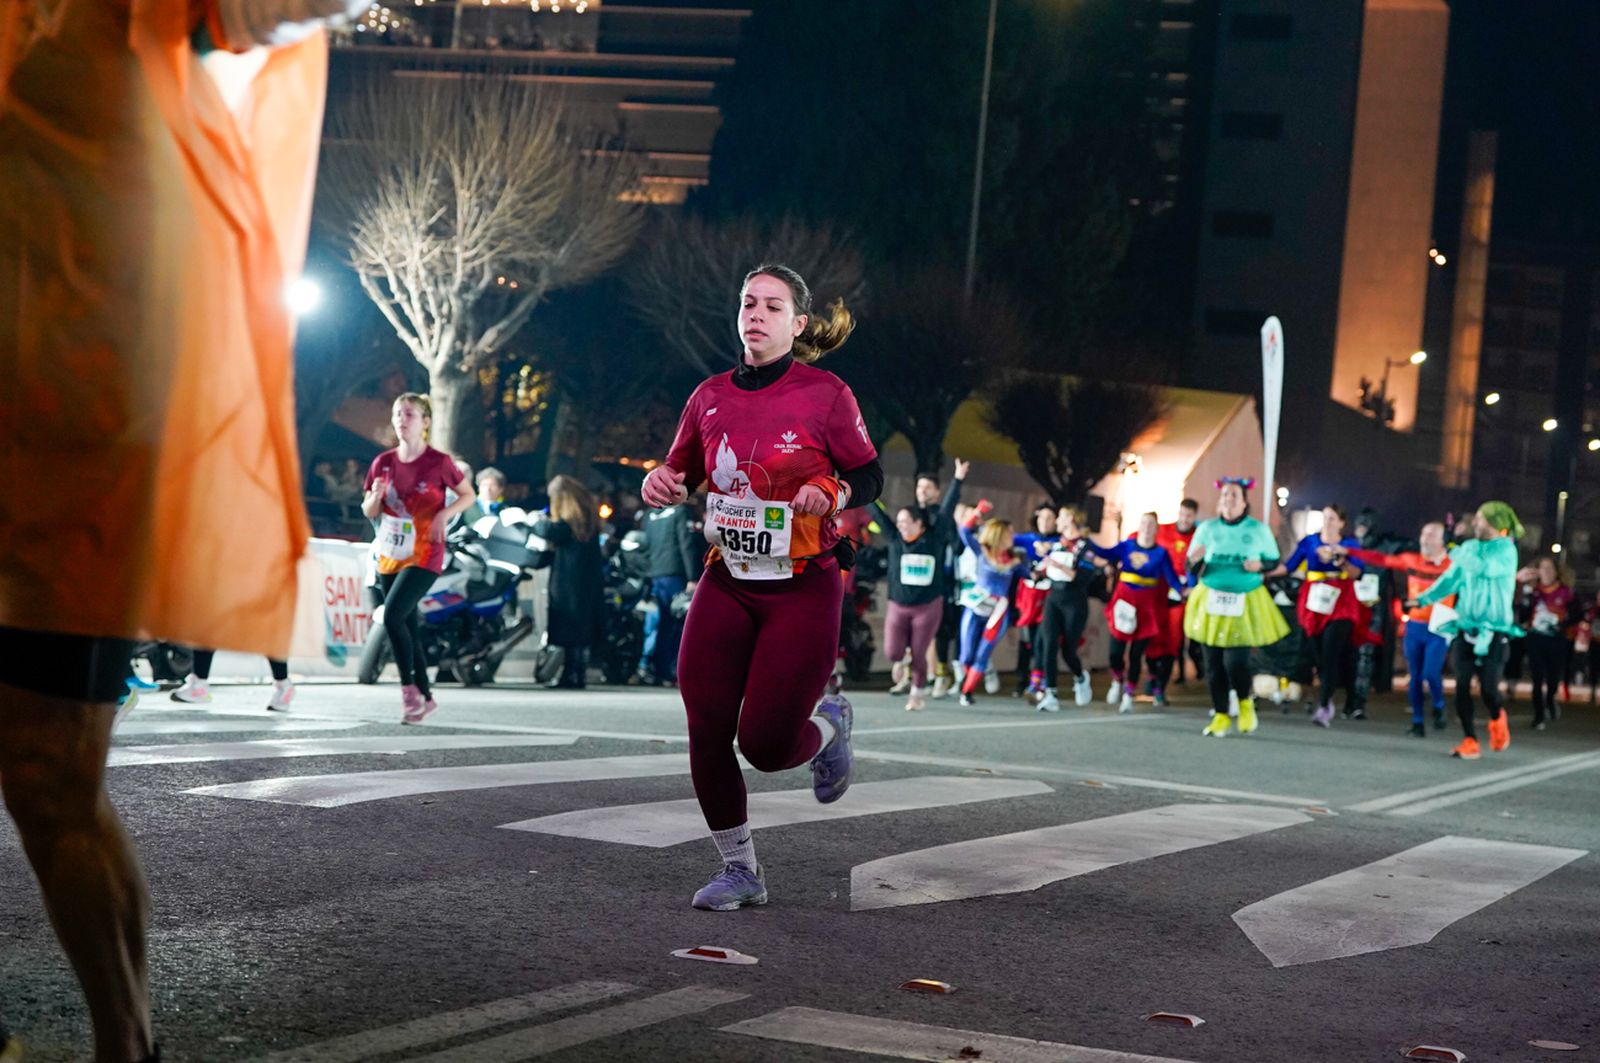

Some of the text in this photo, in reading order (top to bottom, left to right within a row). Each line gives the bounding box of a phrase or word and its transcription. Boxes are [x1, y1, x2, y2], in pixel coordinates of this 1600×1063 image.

[729, 477, 749, 500] 43
[745, 509, 756, 518] DE
[324, 575, 362, 608] SAN
